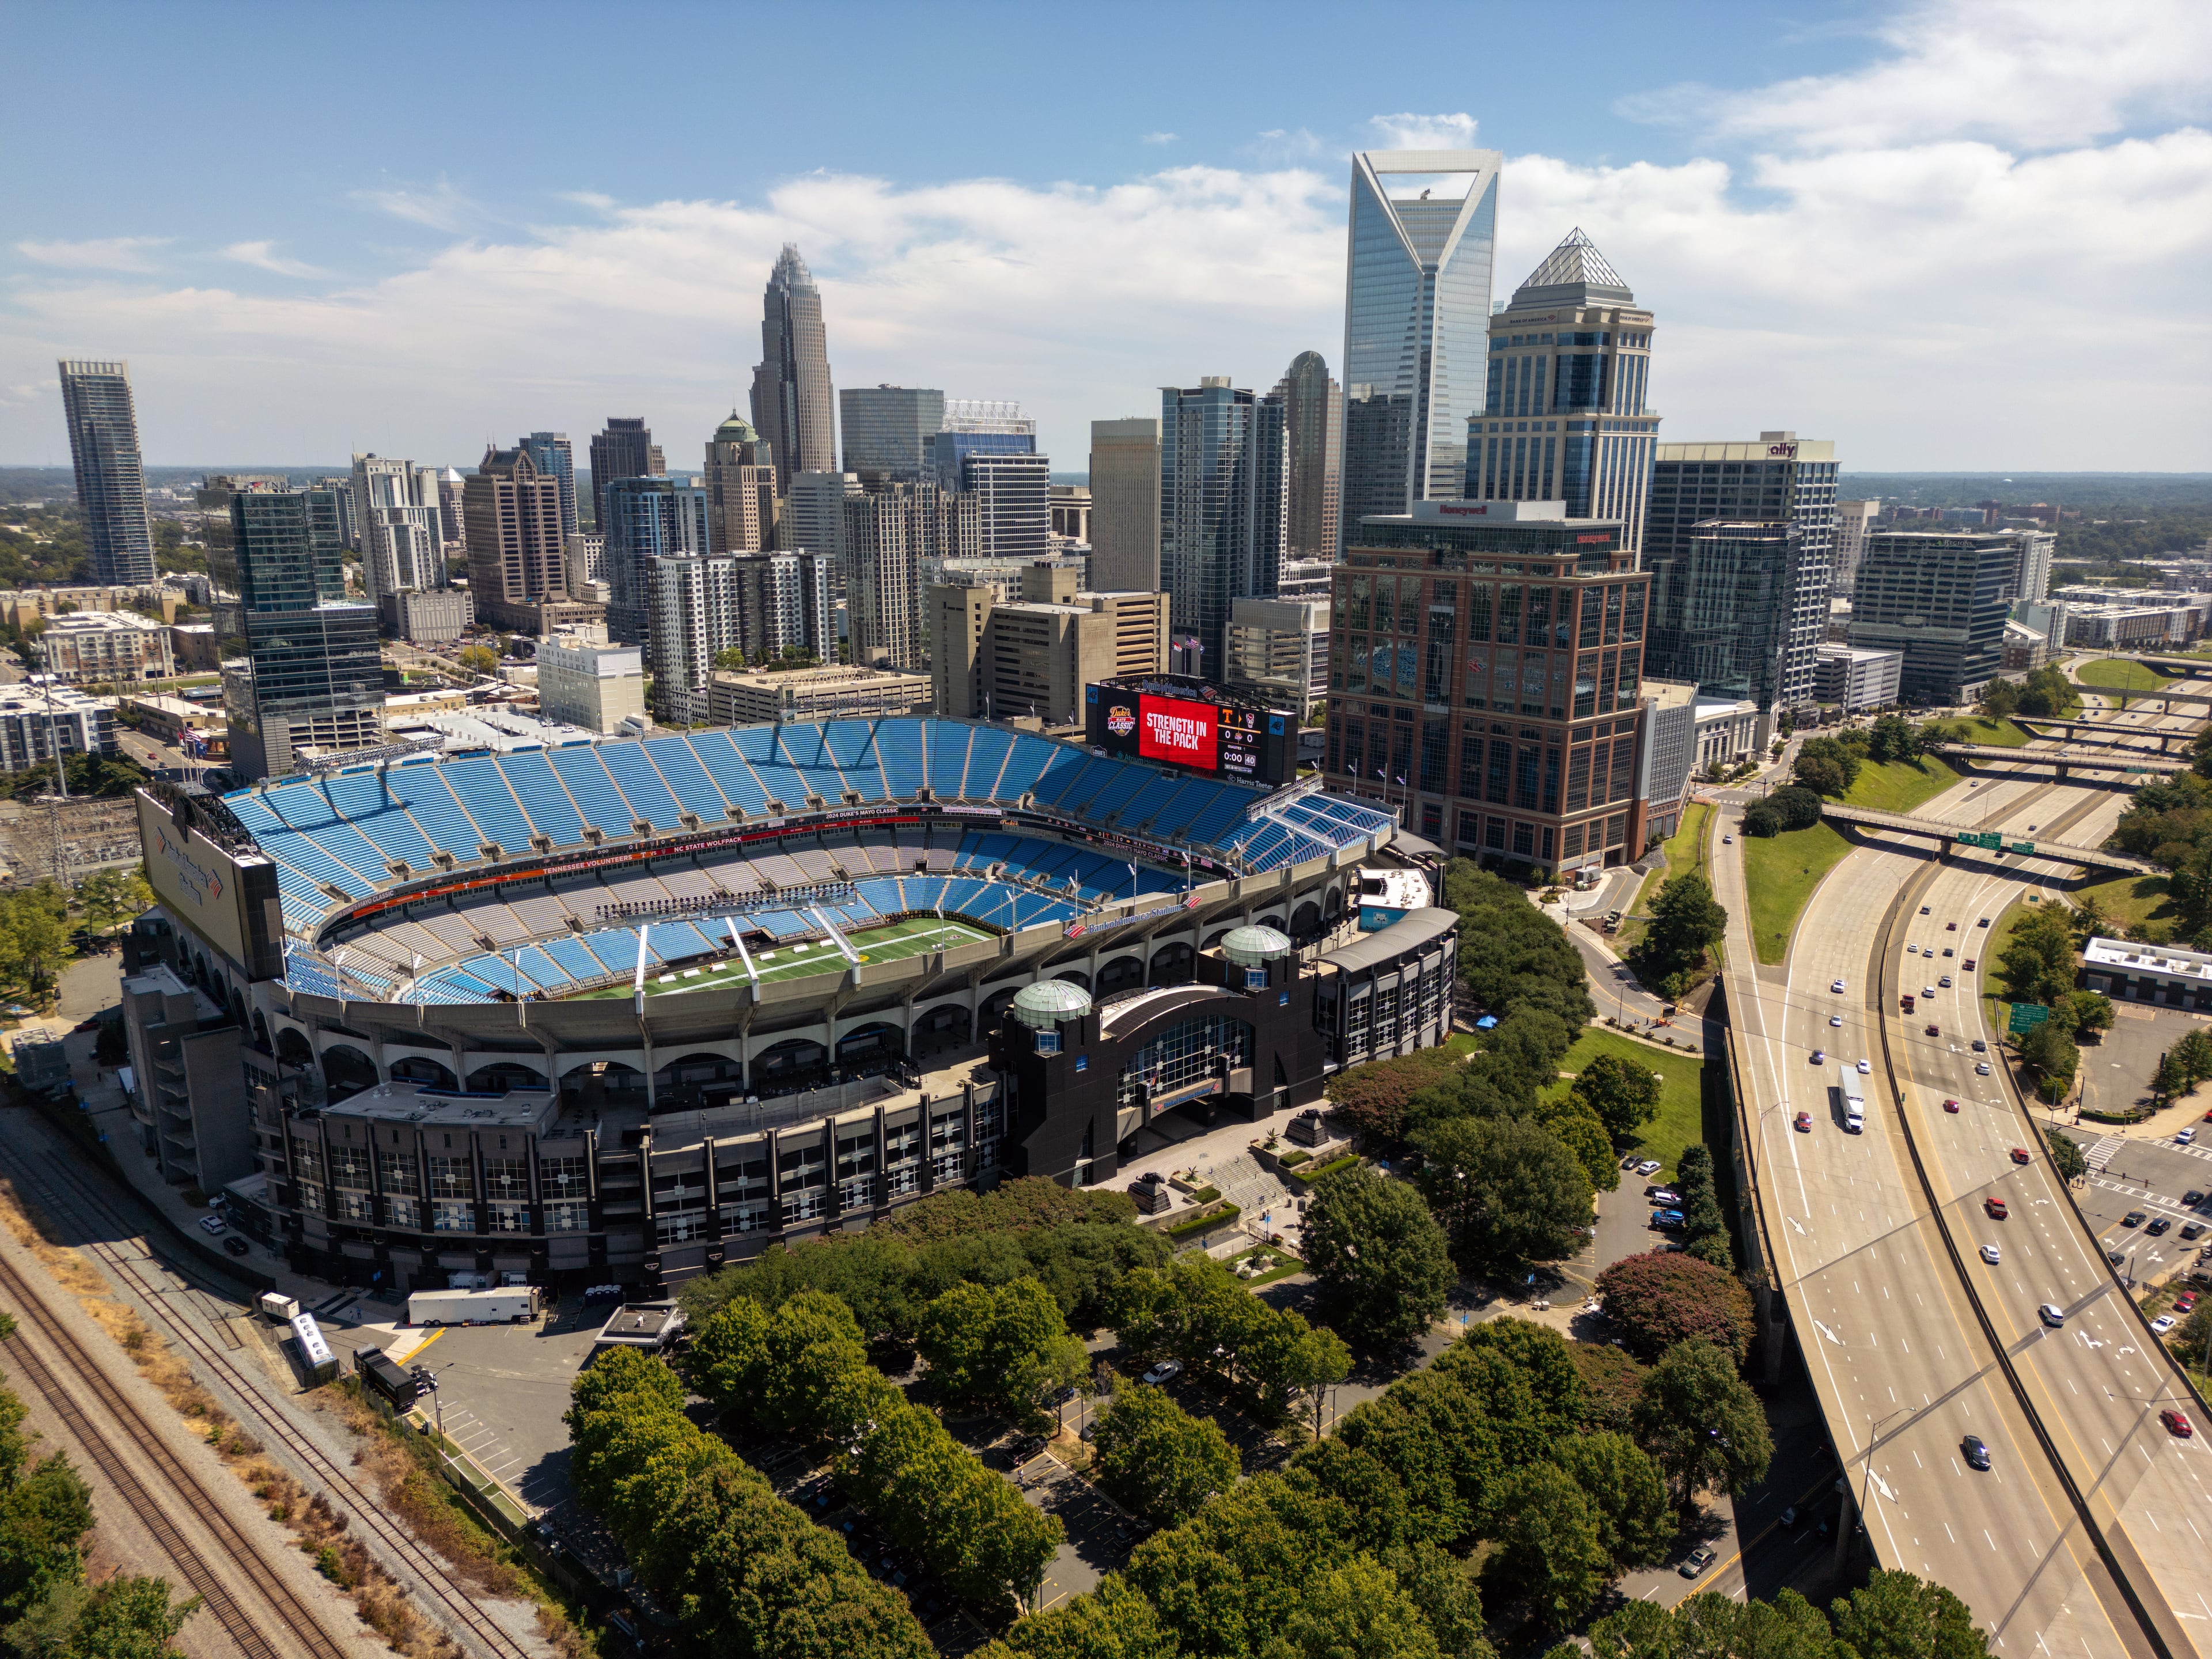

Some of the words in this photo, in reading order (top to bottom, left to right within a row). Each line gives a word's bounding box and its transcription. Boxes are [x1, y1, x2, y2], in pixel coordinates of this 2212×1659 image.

[1770, 442, 1795, 457] ally
[1440, 505, 1487, 516] Honeywell
[1143, 680, 1160, 692] Bank
[1168, 683, 1198, 698] America
[1108, 721, 1133, 729] CLASSIC
[1146, 713, 1194, 734] STRENGTH
[1196, 721, 1207, 737] IN
[1154, 728, 1172, 745] THE
[1173, 732, 1199, 751] PACK
[1225, 730, 1230, 738] 0
[1247, 734, 1252, 743] 0
[1124, 753, 1143, 764] Atrium
[1144, 757, 1162, 767] Health
[1224, 752, 1242, 763] 0:00
[1237, 777, 1255, 786] Harris
[1255, 781, 1274, 790] Teeter
[543, 862, 585, 874] TENNESSEE
[586, 855, 632, 867] VOLUNTEERS
[685, 843, 705, 851] STATE
[706, 836, 742, 847] WOLFPACK
[1103, 840, 1115, 848] 2024
[1116, 843, 1133, 853] DUKE'S
[1133, 847, 1147, 856] MAYO
[1147, 851, 1168, 862] CLASSIC
[358, 898, 372, 908] MAYO
[372, 890, 395, 903] CLASSIC
[1089, 920, 1109, 934] Bank
[1118, 912, 1150, 926] America
[1152, 903, 1183, 918] Stadium
